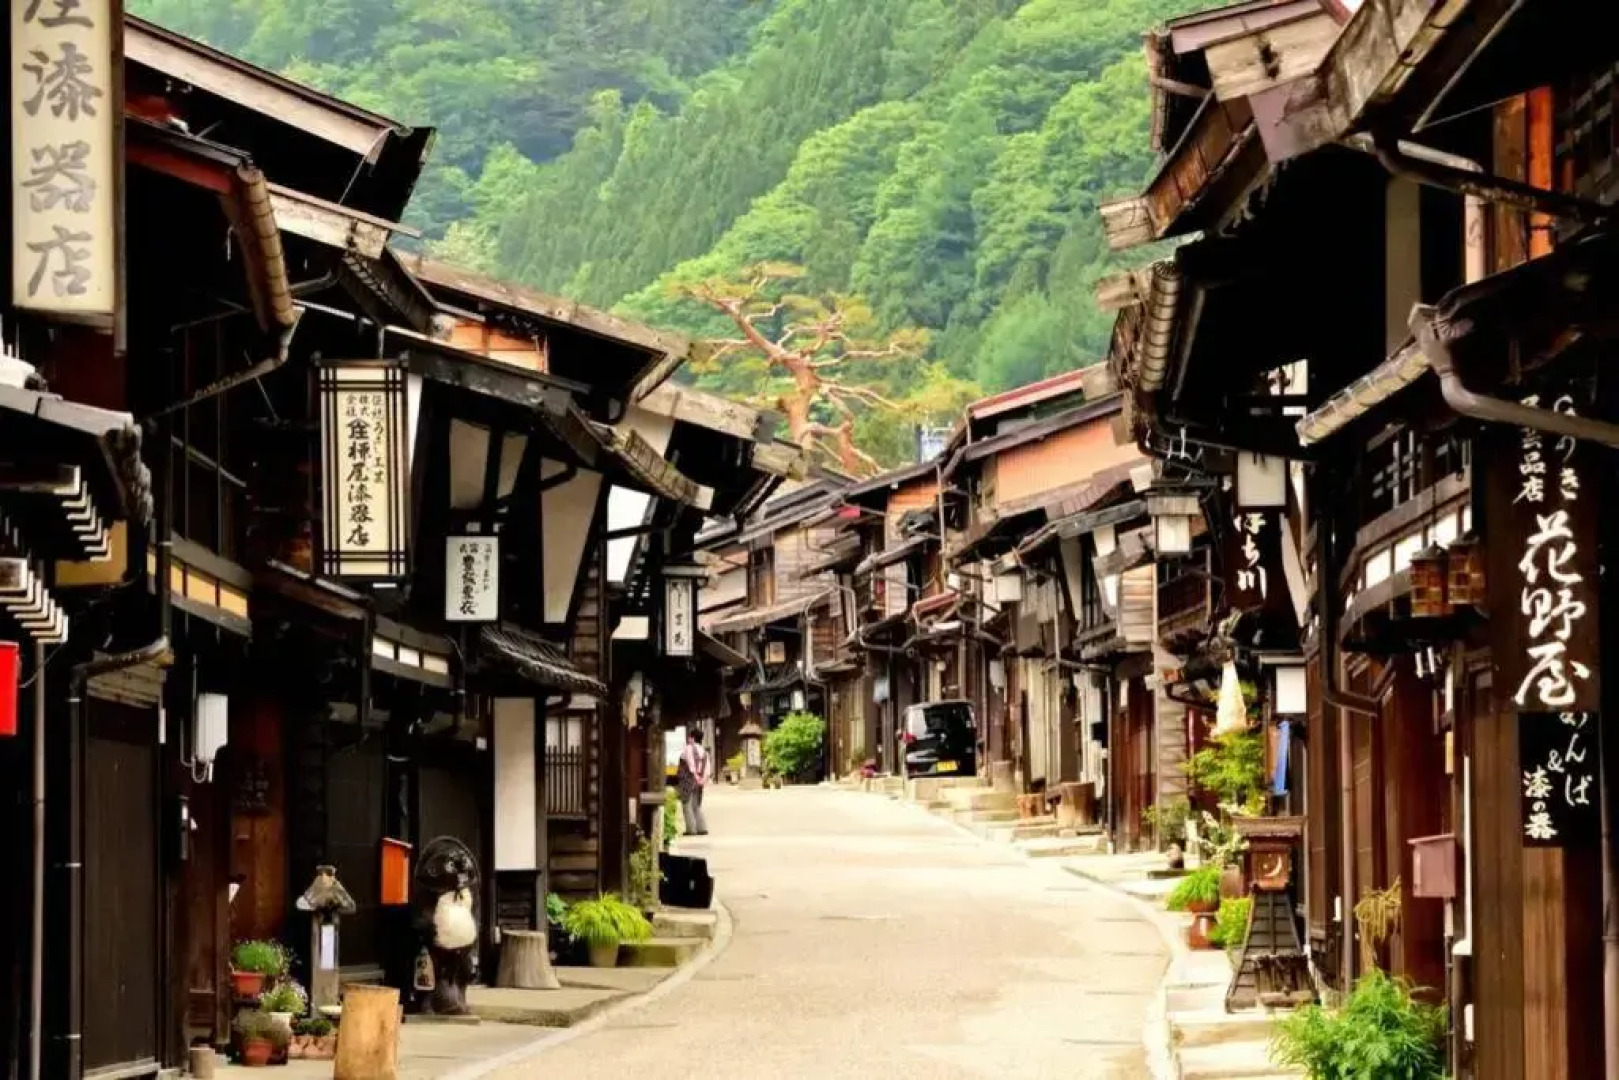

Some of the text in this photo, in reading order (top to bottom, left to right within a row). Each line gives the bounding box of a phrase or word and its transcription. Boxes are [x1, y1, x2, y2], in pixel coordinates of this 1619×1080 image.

[1514, 510, 1591, 705] 花野屋
[1547, 749, 1565, 773] &
